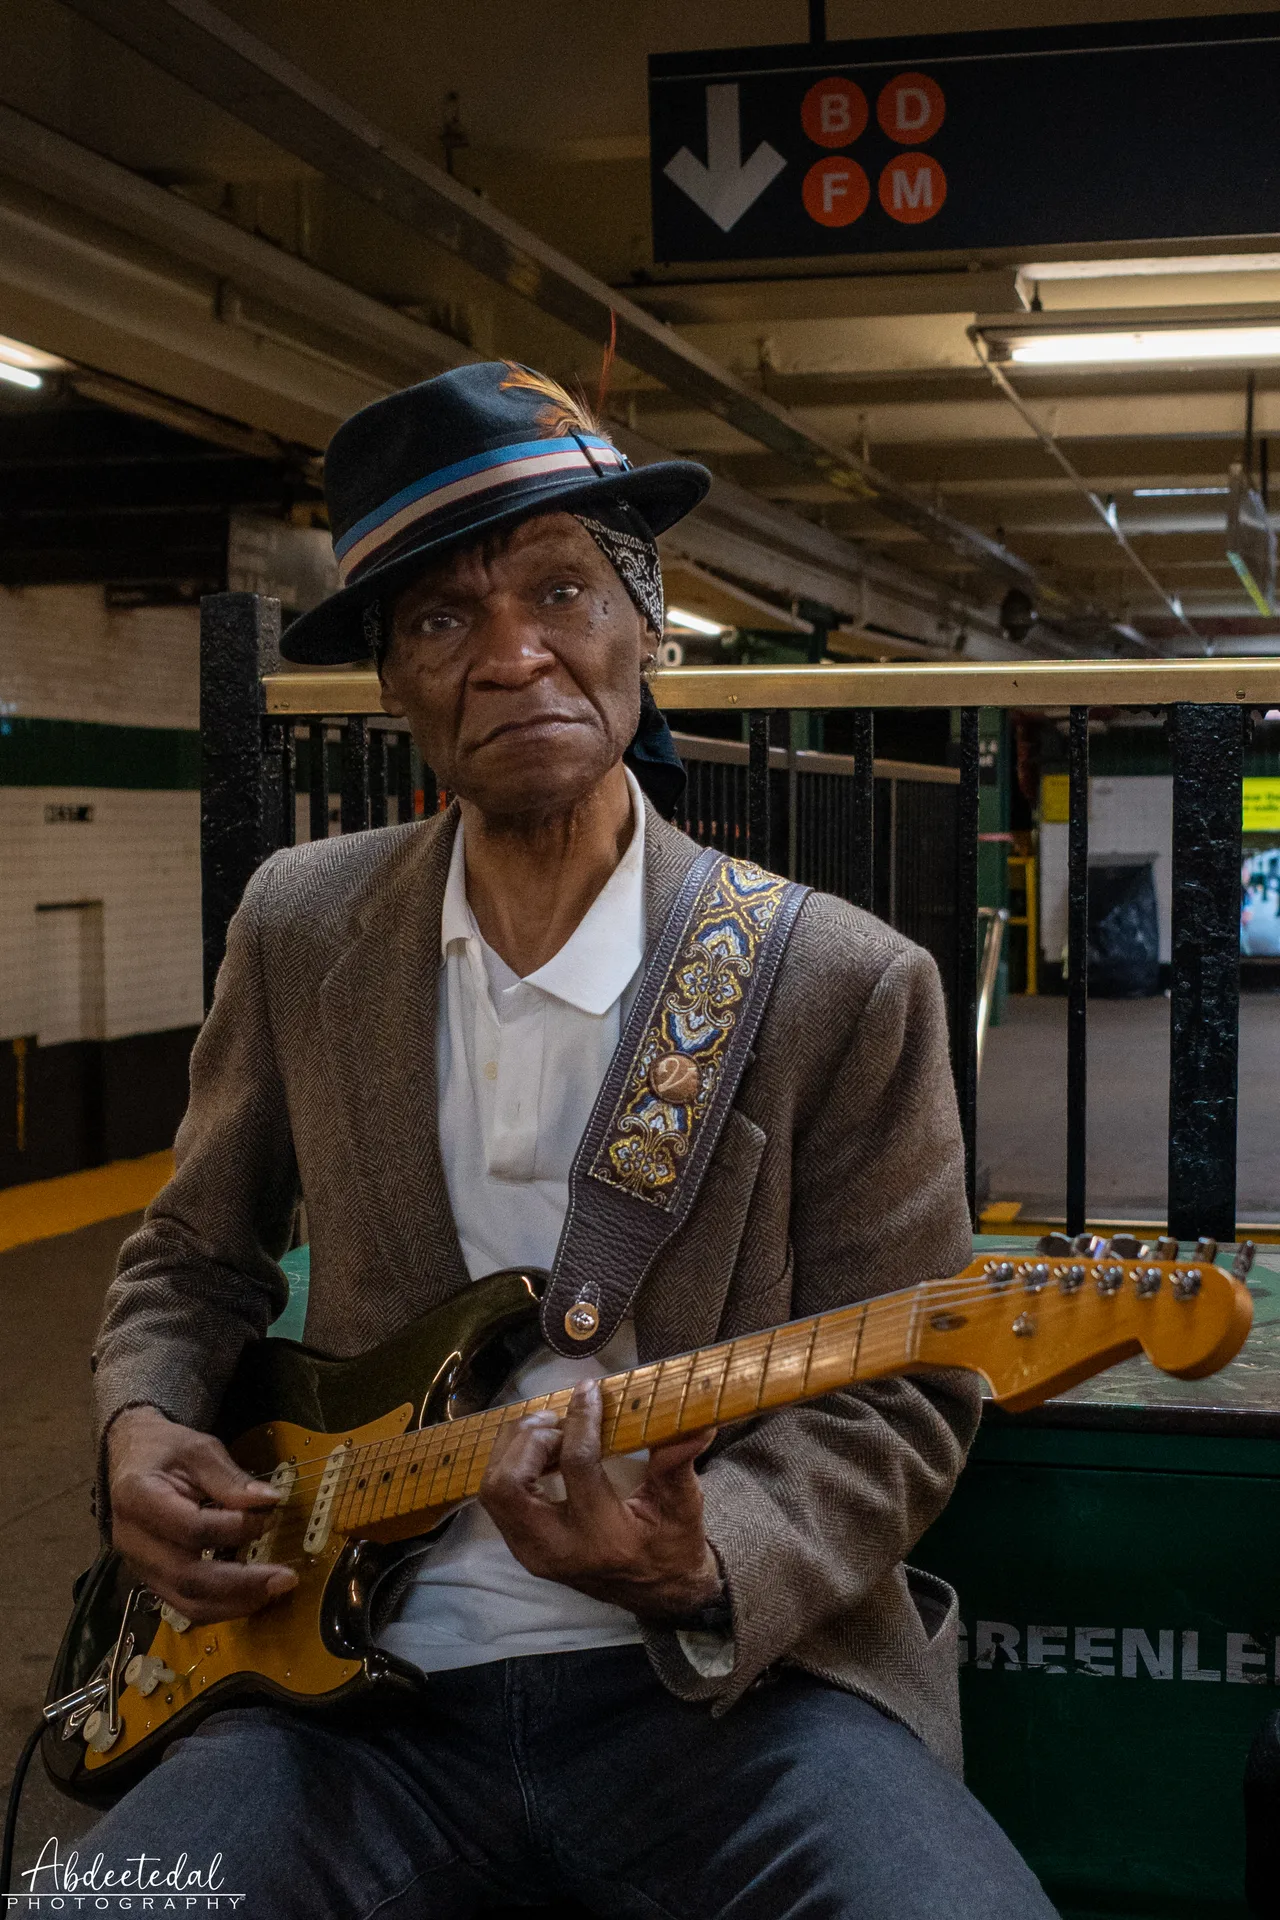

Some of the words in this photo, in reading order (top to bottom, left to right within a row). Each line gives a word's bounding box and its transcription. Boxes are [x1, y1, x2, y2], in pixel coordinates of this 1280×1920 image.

[820, 94, 850, 133] B
[895, 88, 931, 130] D
[822, 172, 849, 213] F
[892, 167, 933, 209] M
[958, 1619, 1280, 1686] REENLE
